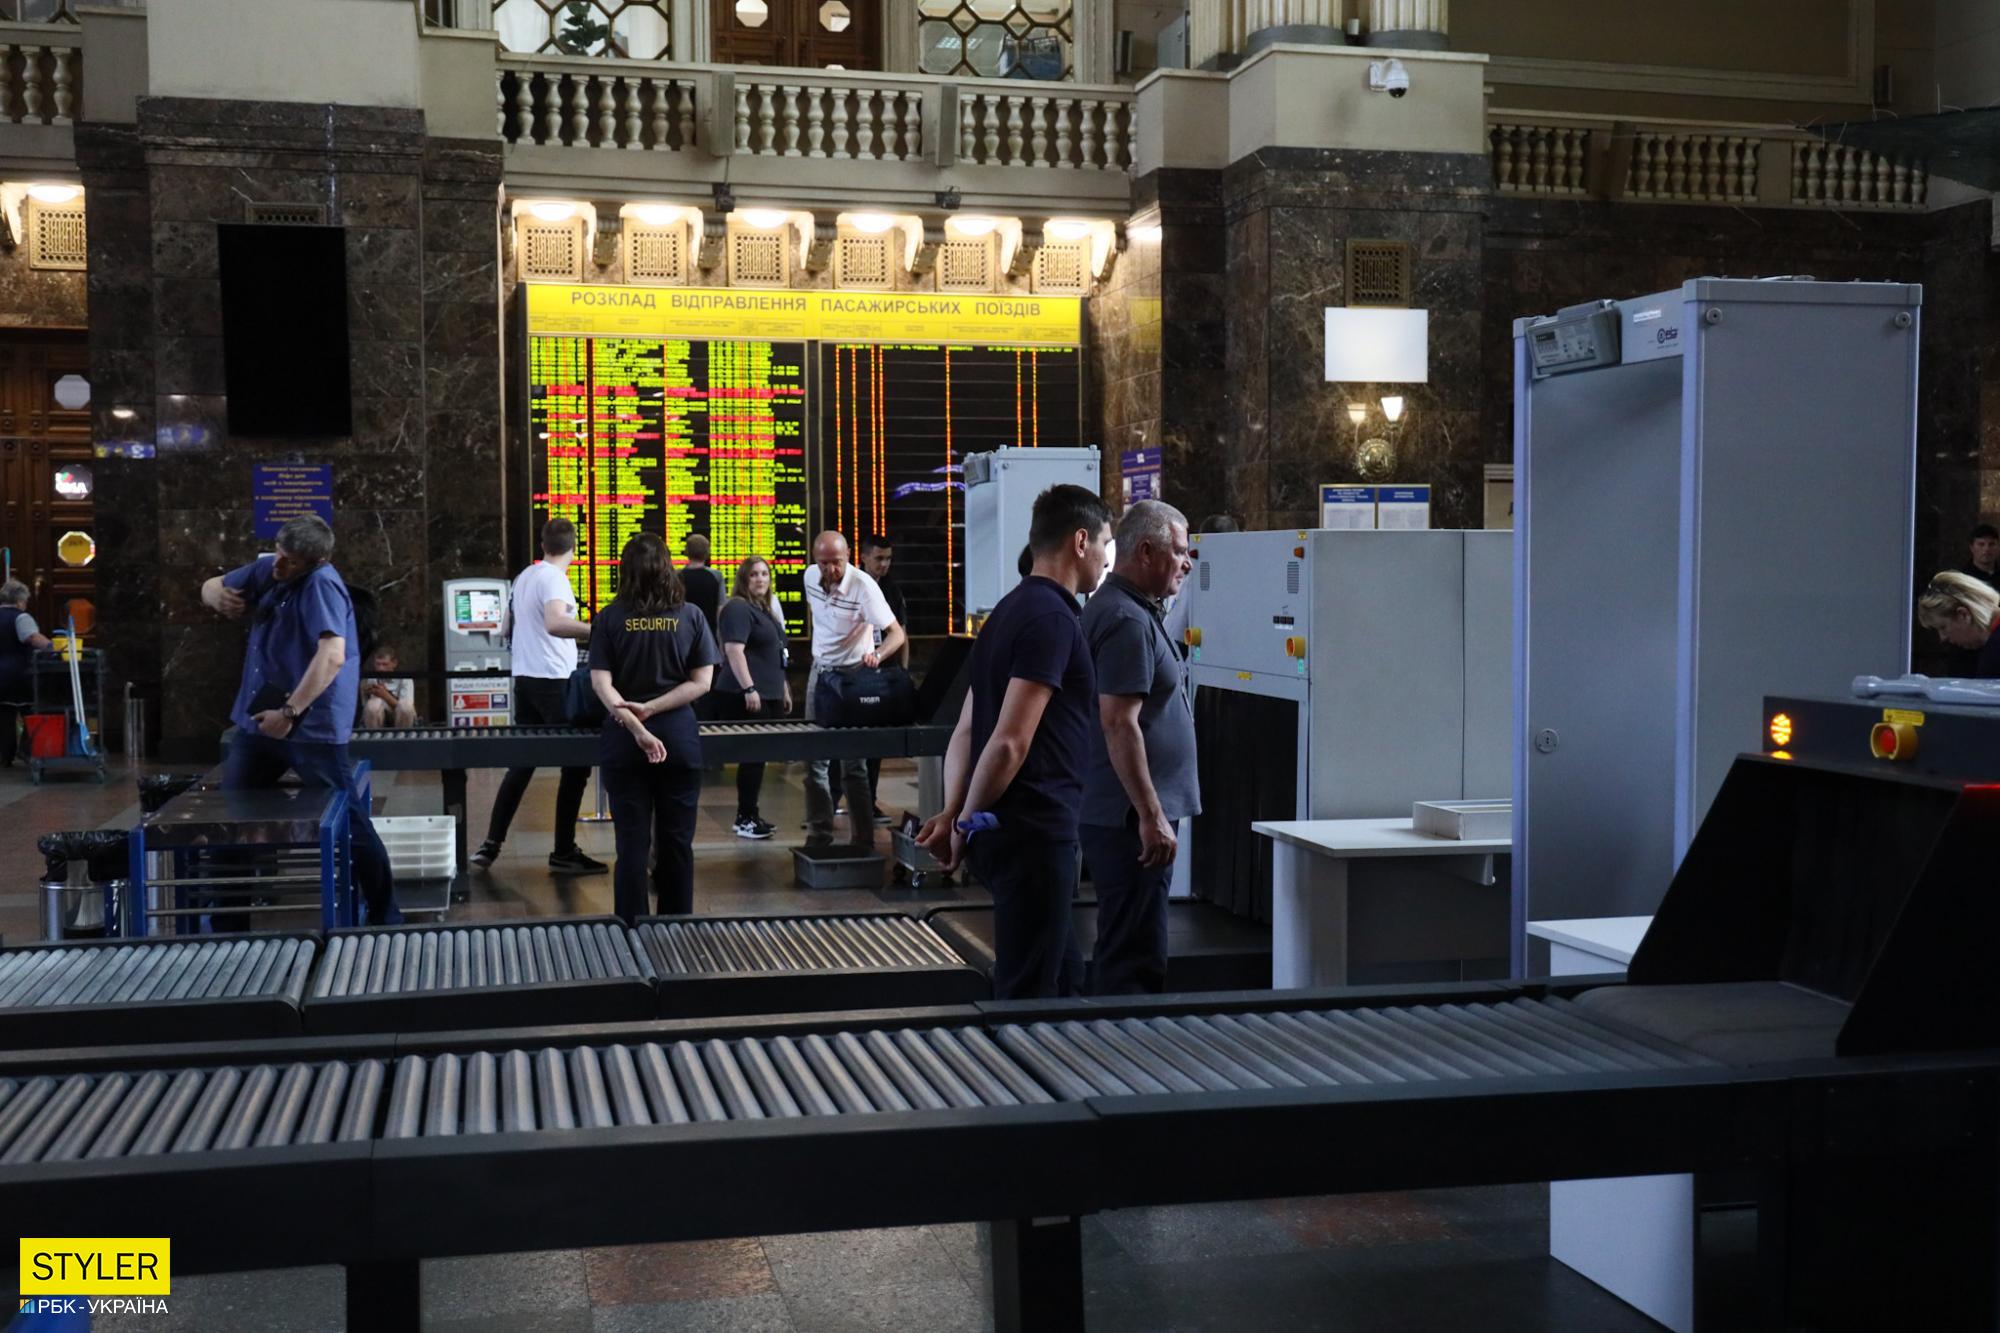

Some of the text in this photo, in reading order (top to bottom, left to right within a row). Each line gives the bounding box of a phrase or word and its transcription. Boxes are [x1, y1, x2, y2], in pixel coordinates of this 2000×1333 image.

[571, 291, 1041, 318] РОЗКЛАД ВІДПРАВЛЕННЯ ПАСАЖИРСЬКИХ ПОЇЗДІВ
[625, 617, 679, 633] SECURITY
